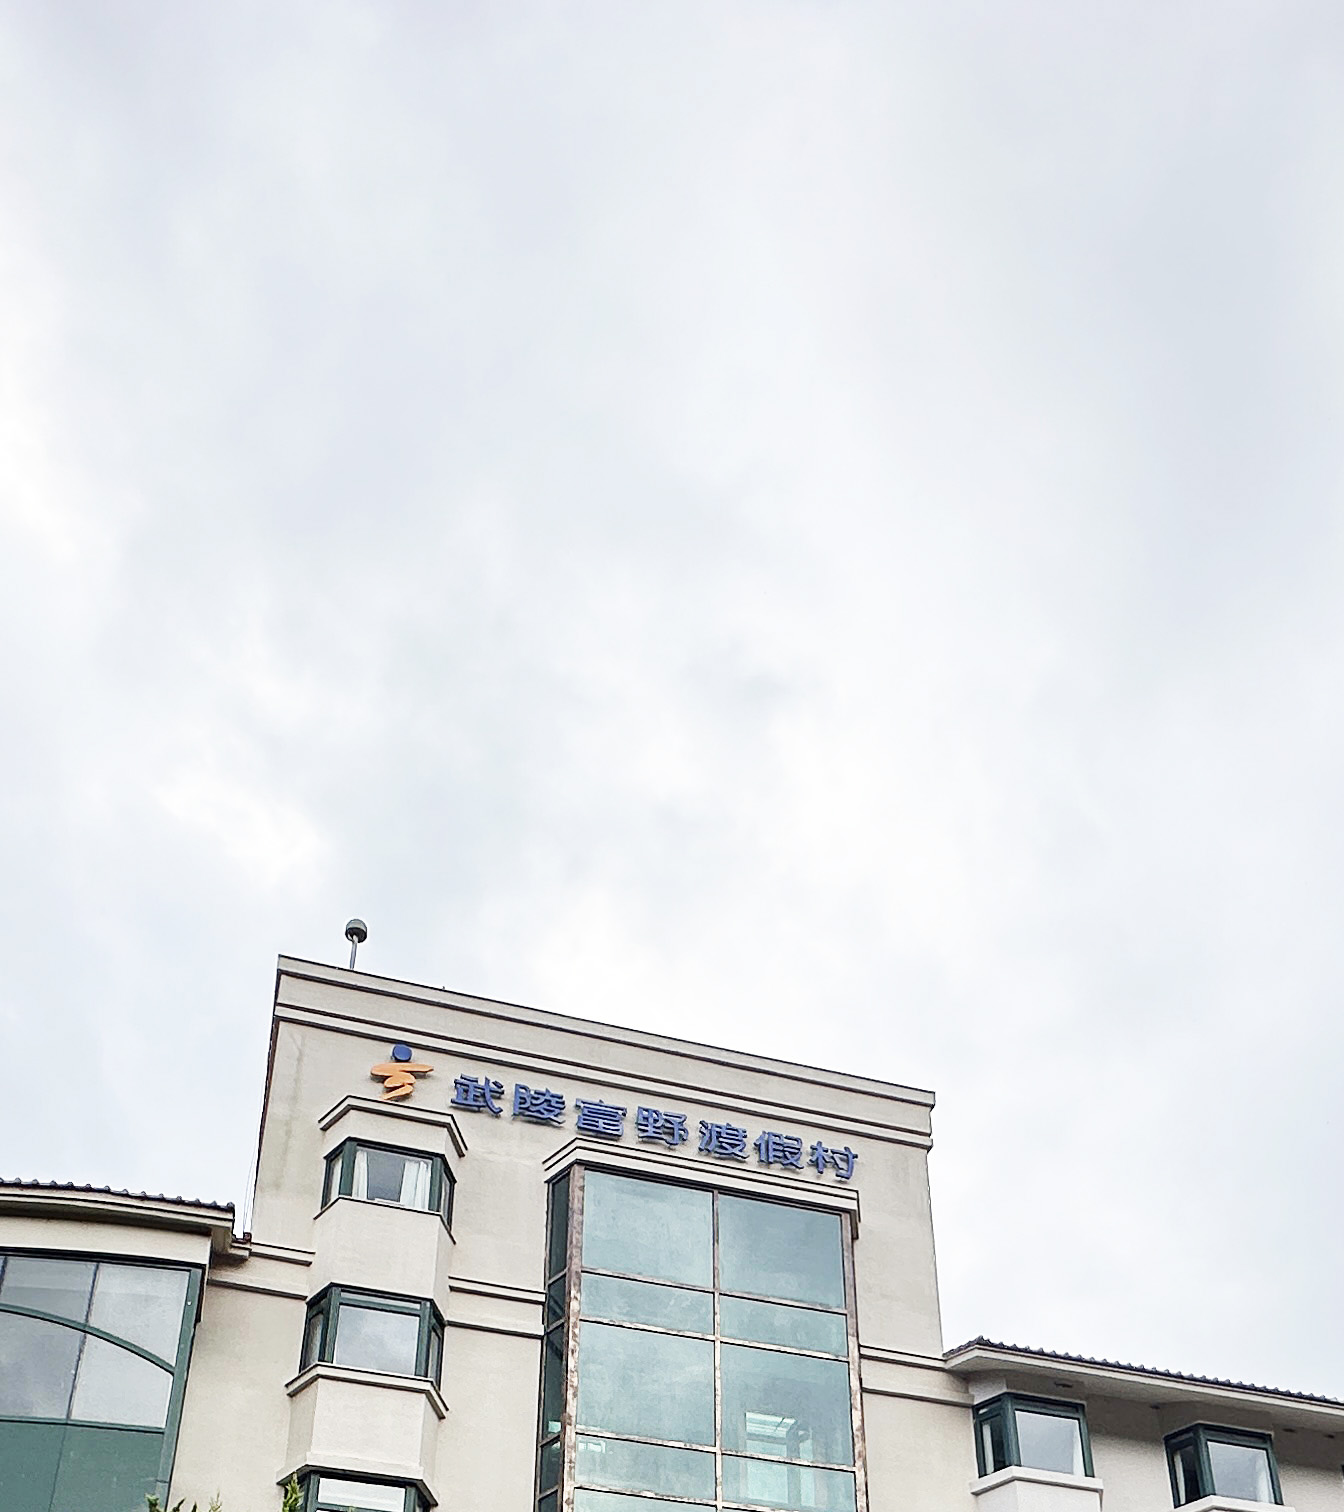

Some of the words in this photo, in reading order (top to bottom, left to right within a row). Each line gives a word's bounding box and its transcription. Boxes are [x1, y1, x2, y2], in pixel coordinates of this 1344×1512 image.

[450, 1073, 859, 1181] 武陵富野渡假村
